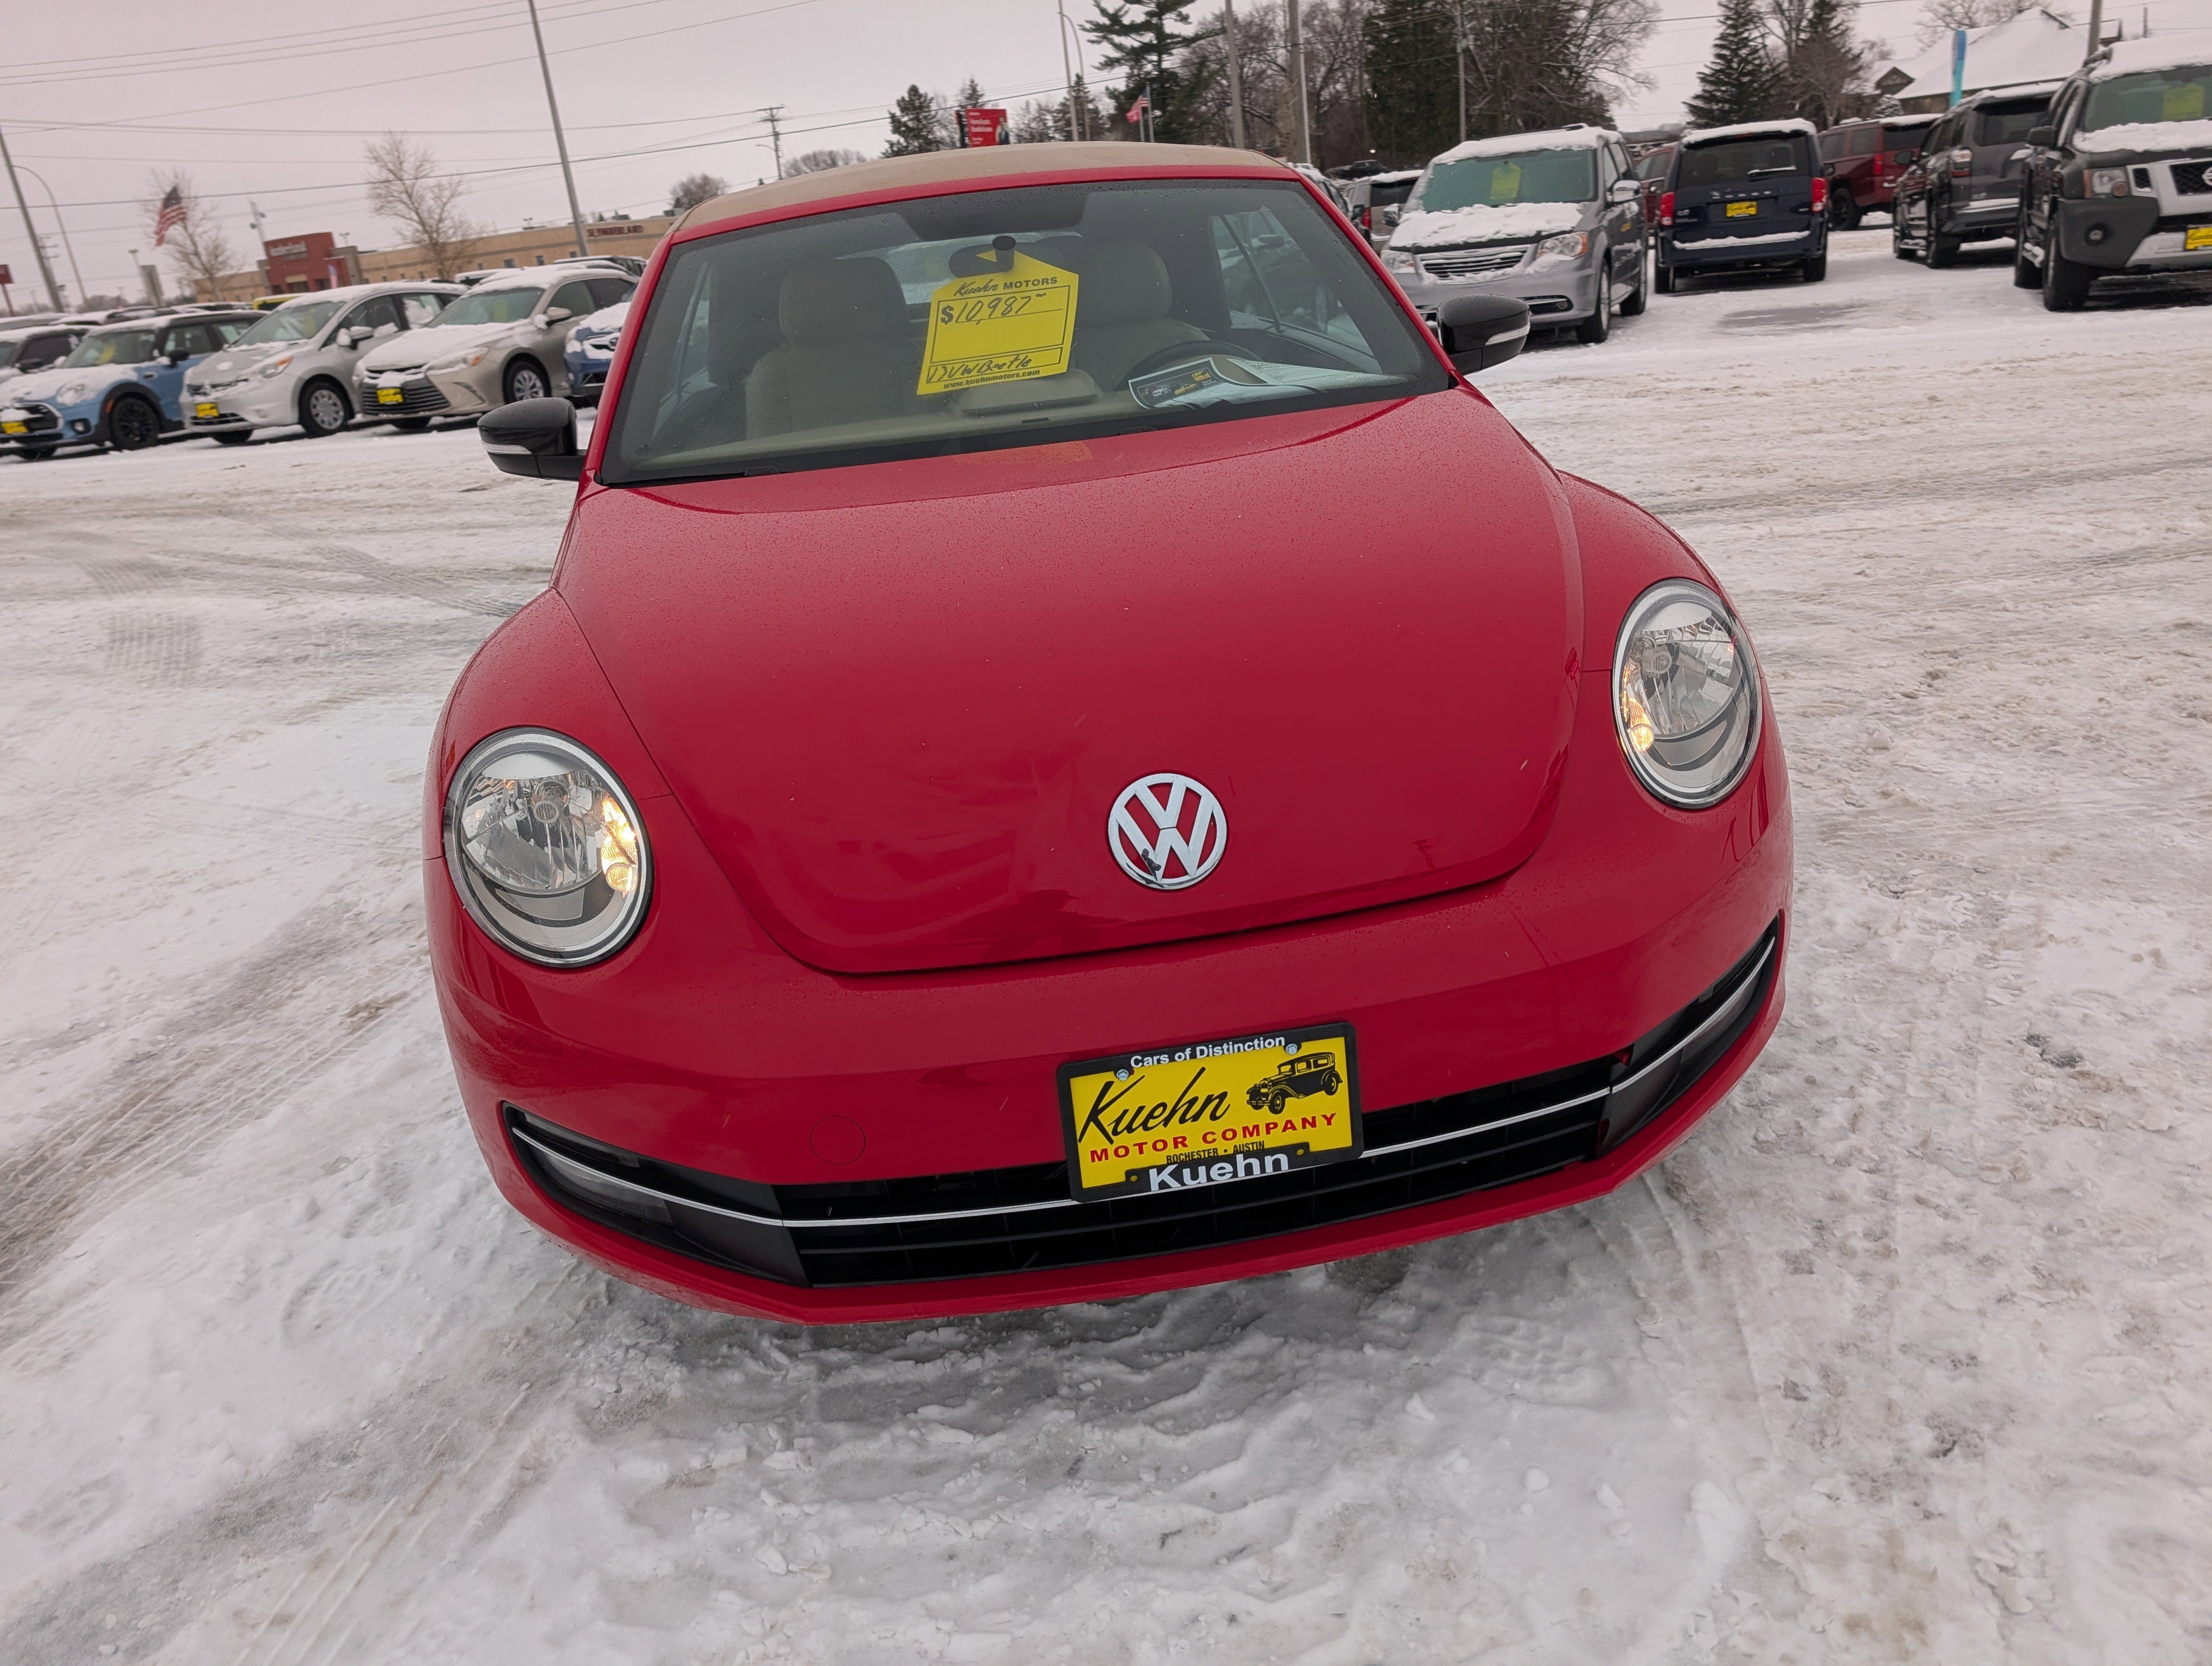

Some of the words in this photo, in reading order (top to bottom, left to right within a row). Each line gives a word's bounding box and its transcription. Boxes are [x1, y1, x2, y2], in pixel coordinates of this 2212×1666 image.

[954, 278, 999, 297] Kuehn
[1004, 277, 1057, 290] MOTORS
[943, 369, 1040, 389] www.kuehnmotors.com
[1130, 1054, 1169, 1069] Cars
[1174, 1047, 1192, 1061] of
[1195, 1035, 1285, 1060] Distinction
[1078, 1067, 1231, 1145] Kuehn
[1090, 1135, 1187, 1163] MOTOR
[1202, 1112, 1337, 1145] COMPANY
[1166, 1147, 1219, 1164] ROCHESTER
[1232, 1139, 1265, 1154] AUSTIN
[1149, 1152, 1289, 1191] Kuehn
